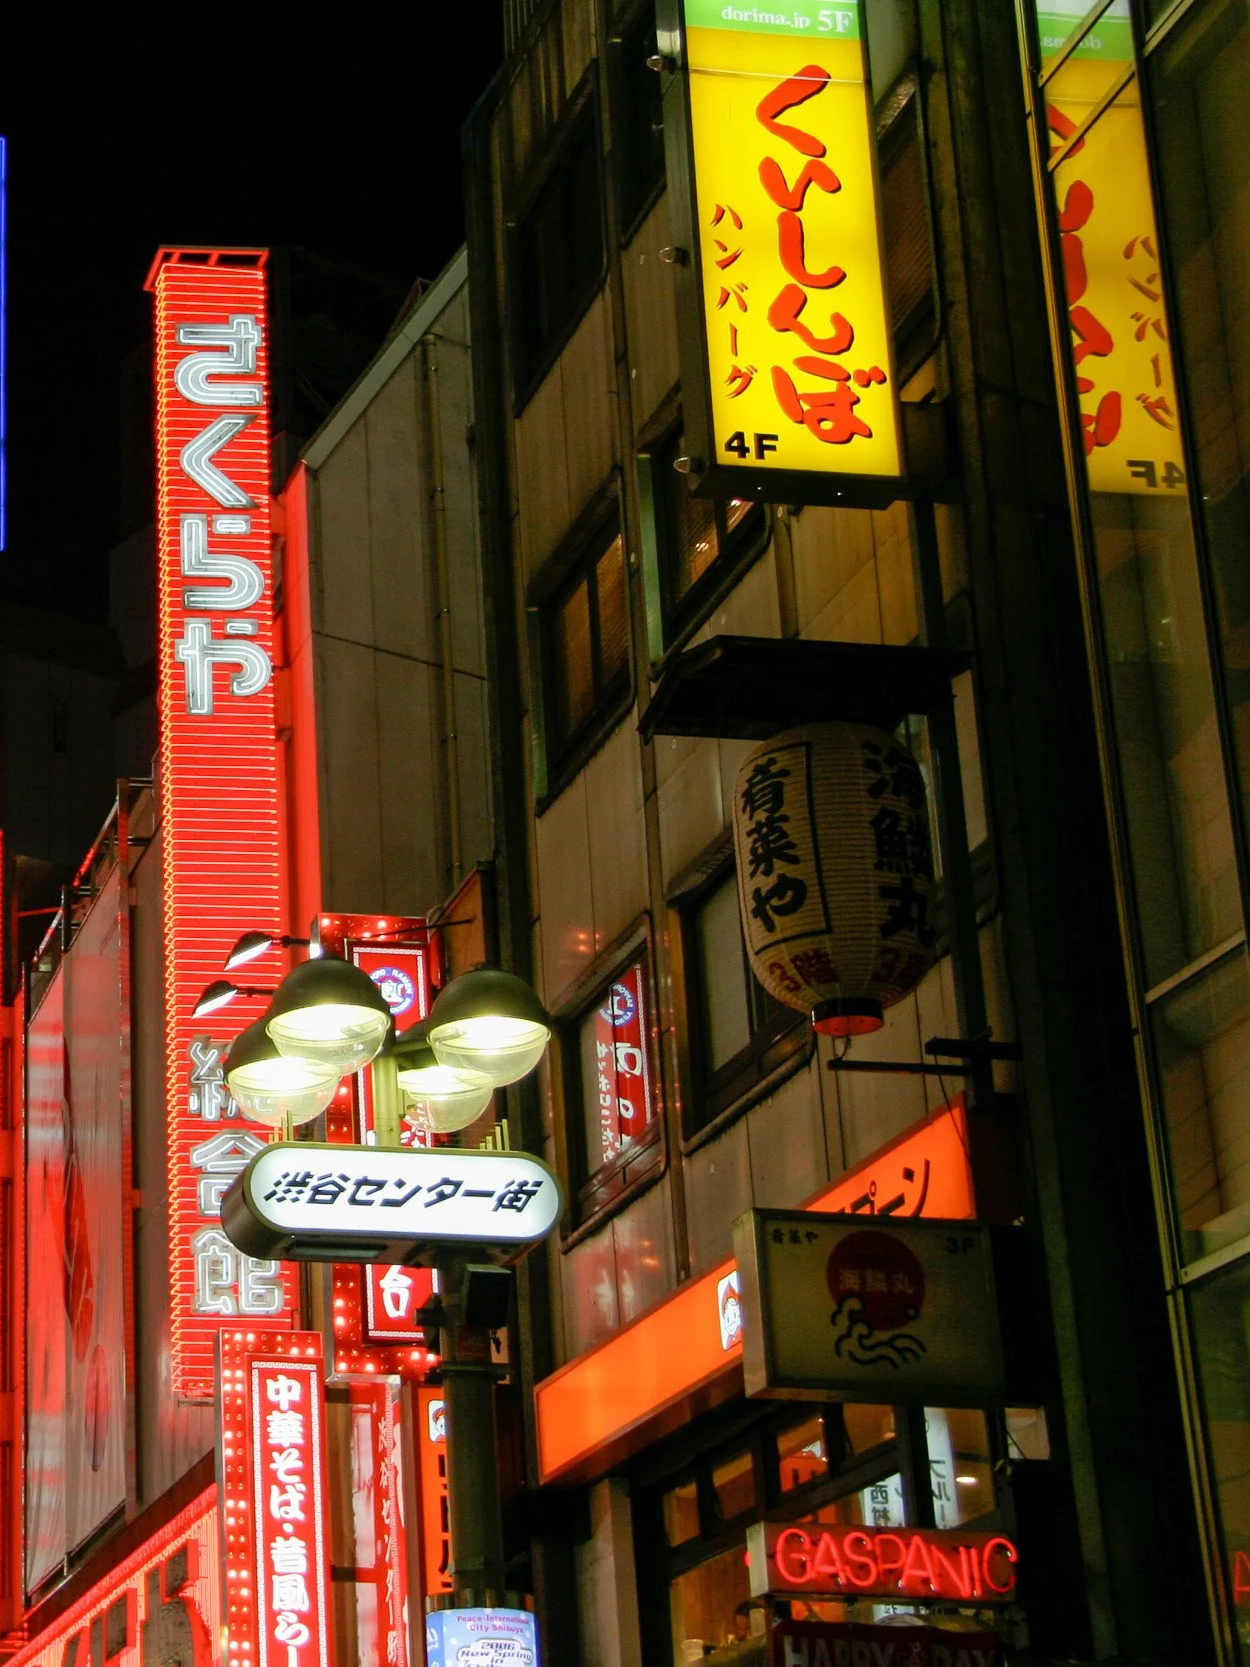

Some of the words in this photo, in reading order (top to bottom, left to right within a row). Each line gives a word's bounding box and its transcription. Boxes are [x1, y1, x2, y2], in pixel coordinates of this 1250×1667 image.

[817, 10, 854, 33] 5F
[710, 203, 757, 400] ハンバーグ
[724, 431, 778, 461] 4F
[174, 314, 272, 715] さくらや
[264, 1170, 544, 1213] 渋谷センター街
[945, 1236, 975, 1254] 3F
[776, 1528, 1017, 1599] GASPANIC
